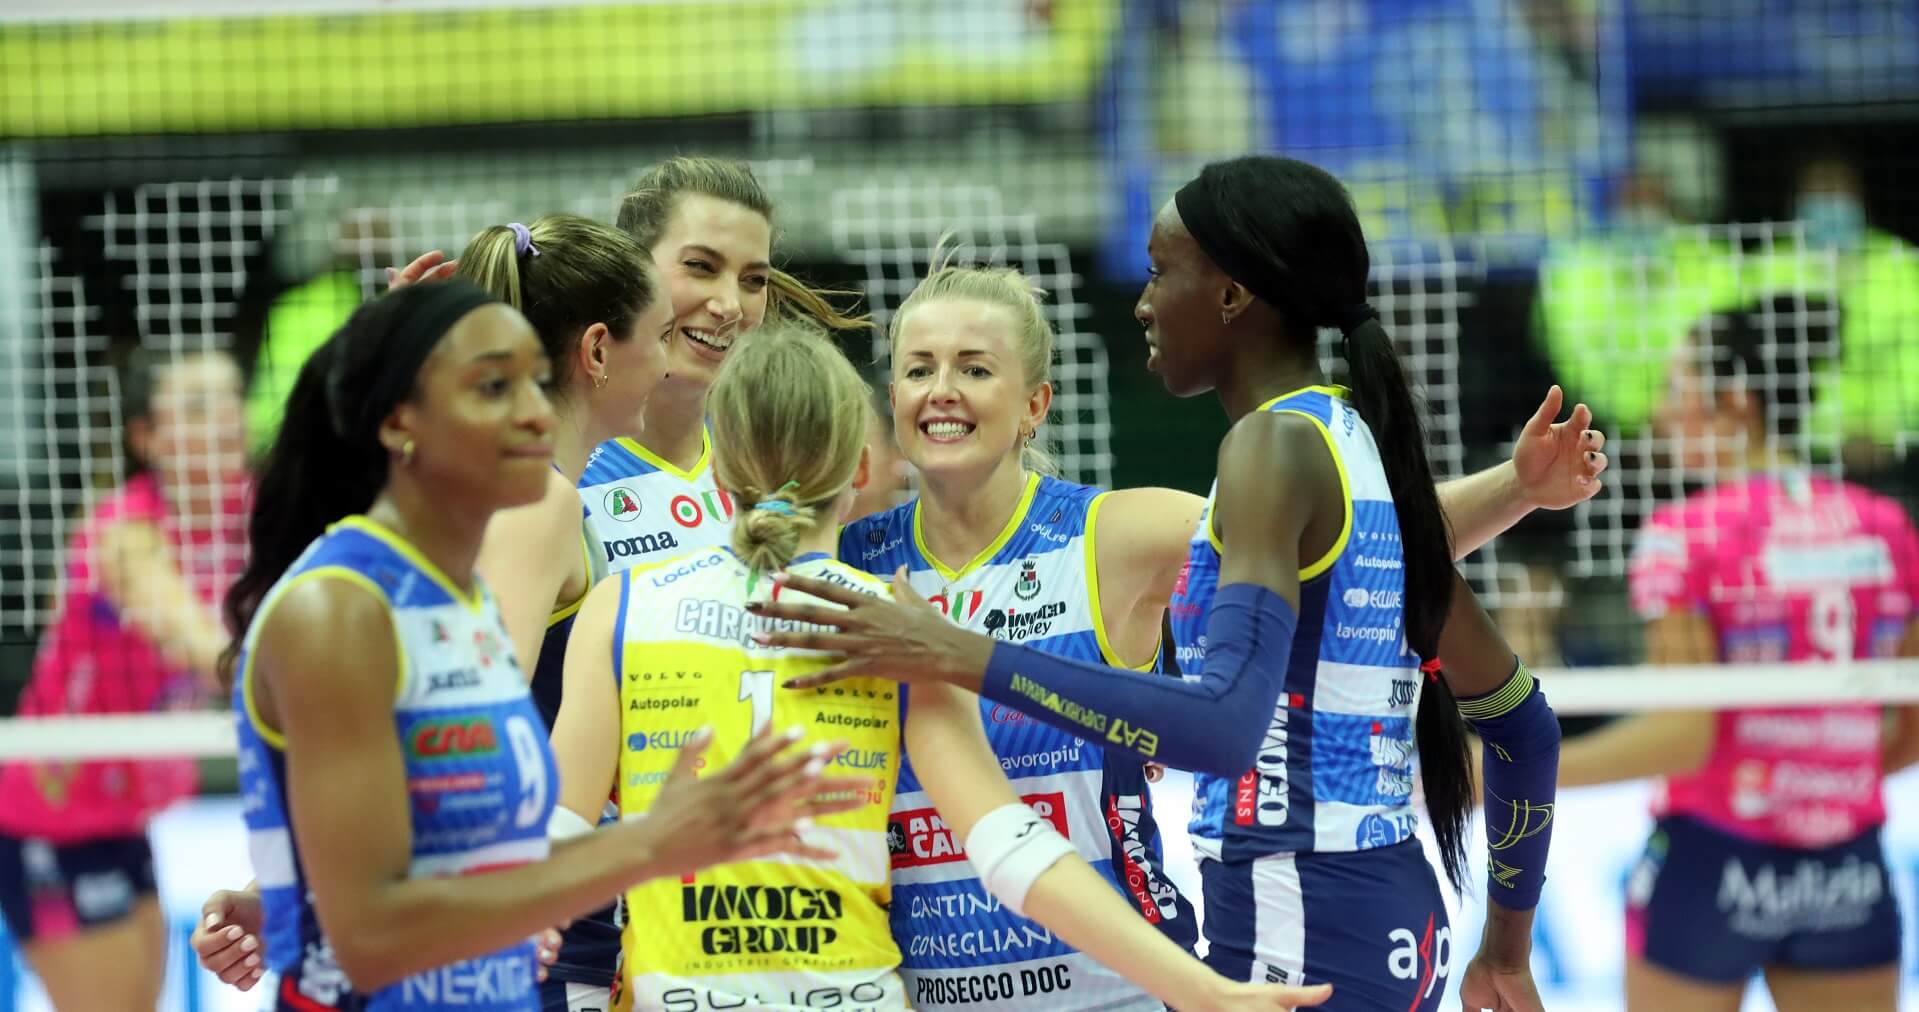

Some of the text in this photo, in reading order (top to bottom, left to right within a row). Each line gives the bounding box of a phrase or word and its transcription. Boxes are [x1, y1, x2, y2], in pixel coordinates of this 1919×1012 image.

[603, 531, 678, 562] Joma
[1009, 621, 1051, 641] Volley
[629, 671, 702, 682] VOLVO
[630, 695, 701, 711] Autopolar
[816, 687, 893, 699] VOLVO
[738, 670, 776, 742] 1
[815, 711, 889, 729] Autopolar
[701, 926, 837, 955] GROUP
[909, 925, 1053, 956] CONEGLIAN
[916, 964, 1071, 1004] PROSECCO DOC
